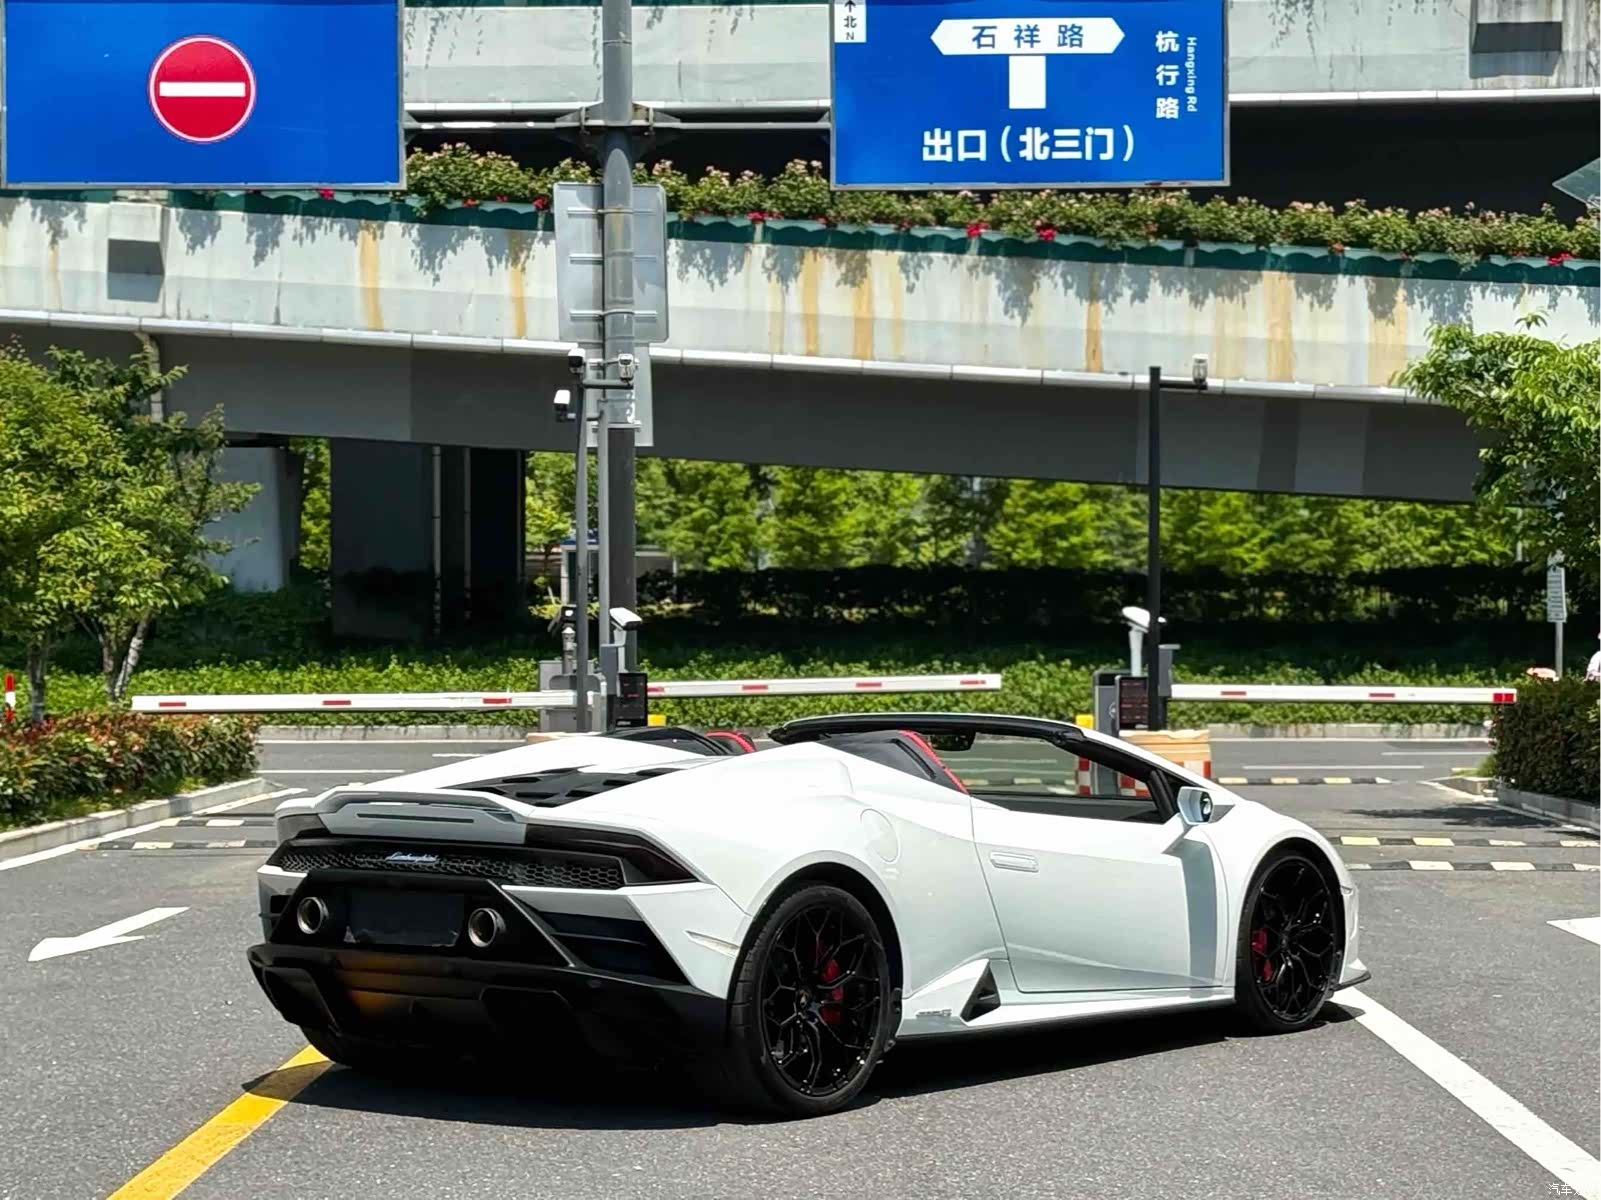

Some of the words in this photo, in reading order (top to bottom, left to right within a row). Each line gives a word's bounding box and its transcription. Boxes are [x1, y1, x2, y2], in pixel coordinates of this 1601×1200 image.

[843, 15, 857, 28] 北
[845, 32, 855, 40] N
[972, 24, 1084, 49] 石祥路
[1155, 30, 1180, 119] 杭行路
[1184, 36, 1197, 94] Hangxing
[1186, 95, 1197, 112] Rd
[922, 125, 1135, 163] 出口（北三门）
